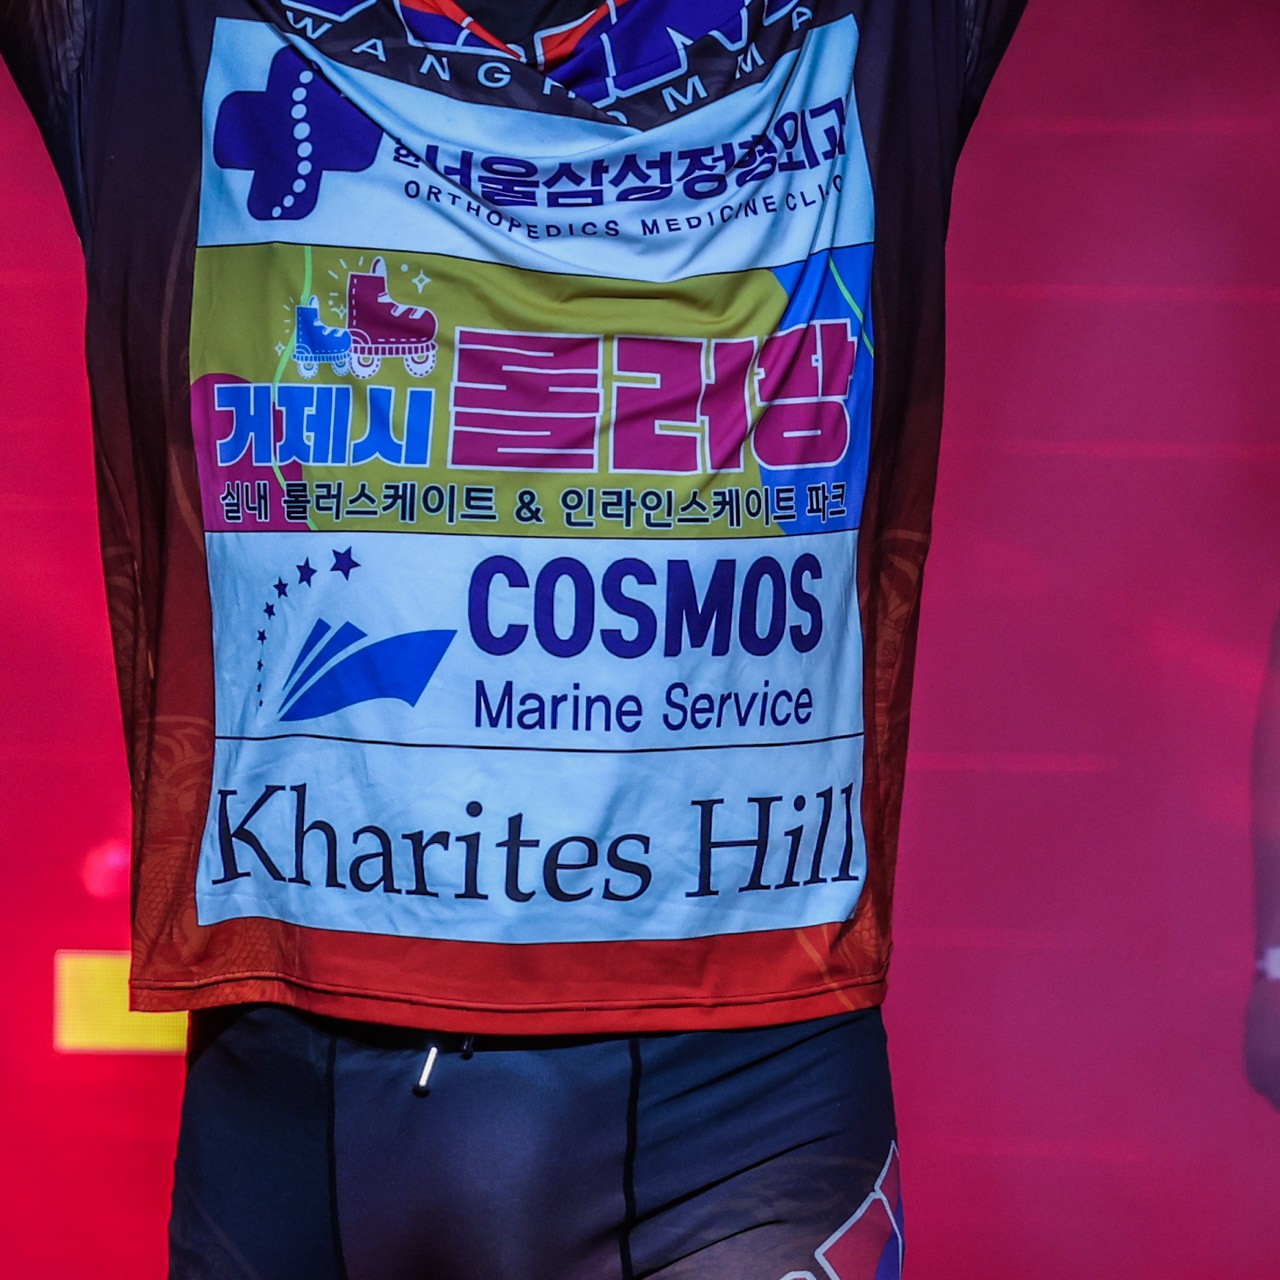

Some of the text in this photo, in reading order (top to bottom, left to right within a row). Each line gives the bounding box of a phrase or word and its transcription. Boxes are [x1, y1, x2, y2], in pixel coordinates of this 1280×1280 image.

[404, 180, 620, 239] ORTHOPEDICS
[641, 195, 777, 236] MEDICINE
[214, 383, 436, 468] 거제시
[220, 480, 846, 529] 실내 롤러스케이트 & 인라인스케이트 파크
[467, 553, 823, 659] COSMOS
[474, 679, 813, 732] Marine Service
[211, 783, 860, 902] Kharites Hill
